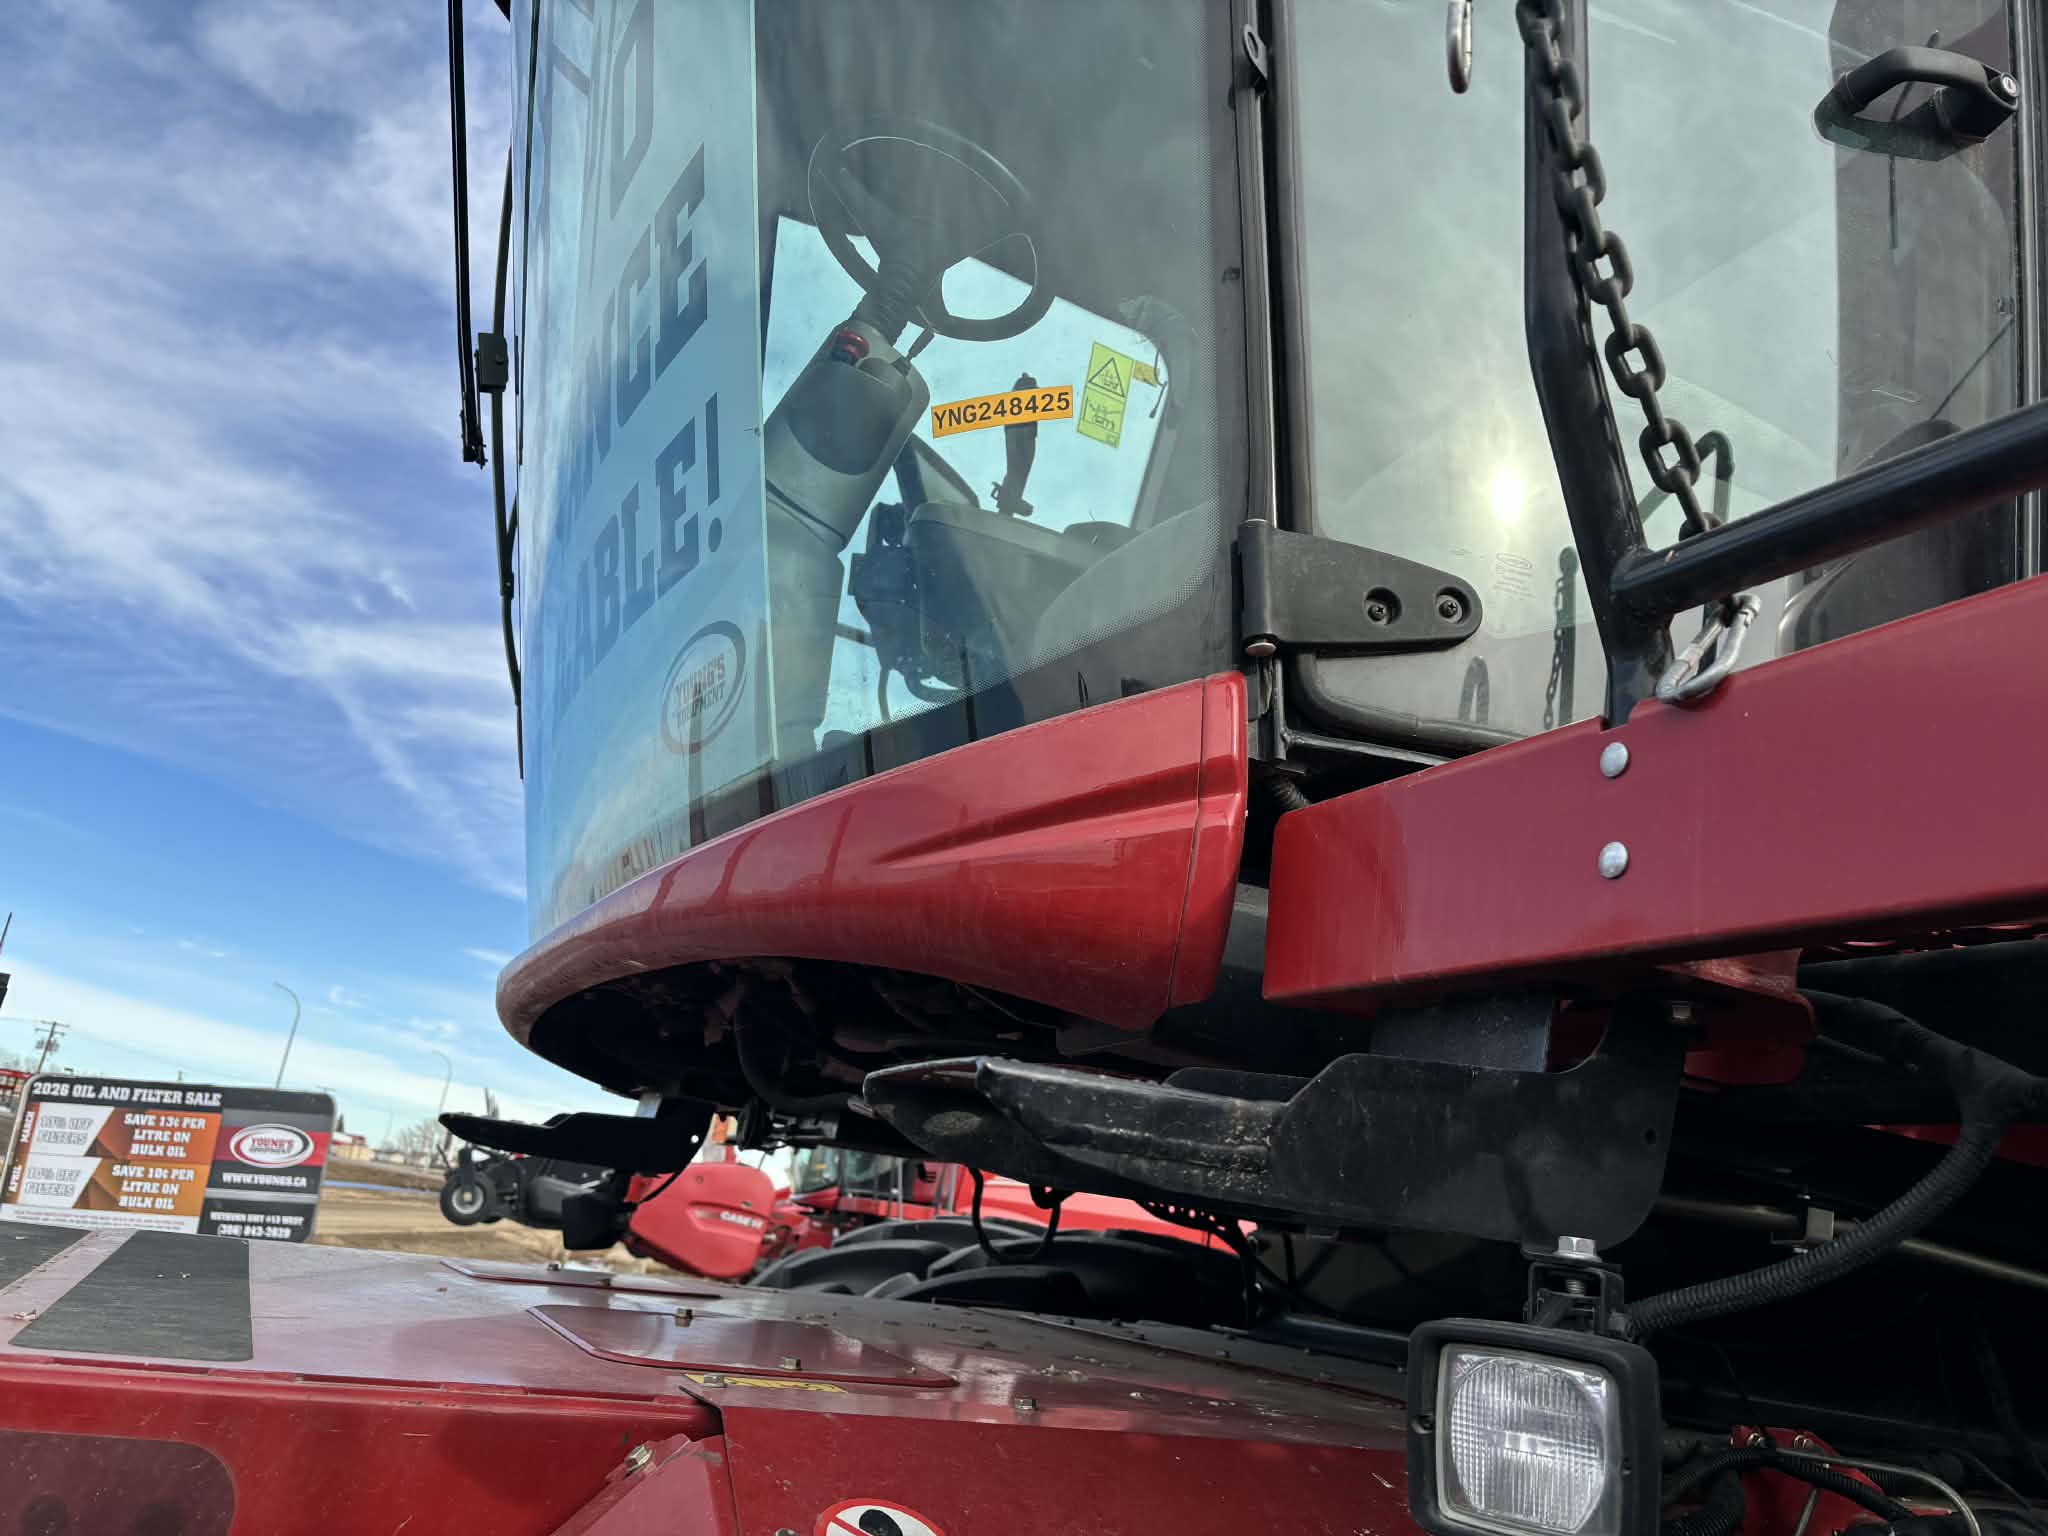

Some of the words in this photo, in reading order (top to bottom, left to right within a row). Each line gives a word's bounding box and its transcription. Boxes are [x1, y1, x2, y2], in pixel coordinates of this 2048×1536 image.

[934, 391, 1070, 430] YNG248425
[72, 1084, 96, 1098] OIL
[98, 1086, 131, 1101] AND
[132, 1087, 182, 1104] FILTER
[185, 1091, 222, 1106] SALE
[124, 1113, 156, 1126] SAVE
[182, 1117, 206, 1129] PER
[134, 1129, 171, 1142] LITRE
[173, 1132, 191, 1143] ON
[130, 1143, 164, 1156] BULK
[167, 1146, 187, 1158] OIL
[112, 1164, 144, 1177] SAVE
[171, 1169, 195, 1181] PER
[122, 1180, 160, 1193] LITRE
[162, 1183, 180, 1195] ON
[118, 1195, 153, 1208] BULK
[155, 1198, 175, 1210] OIL
